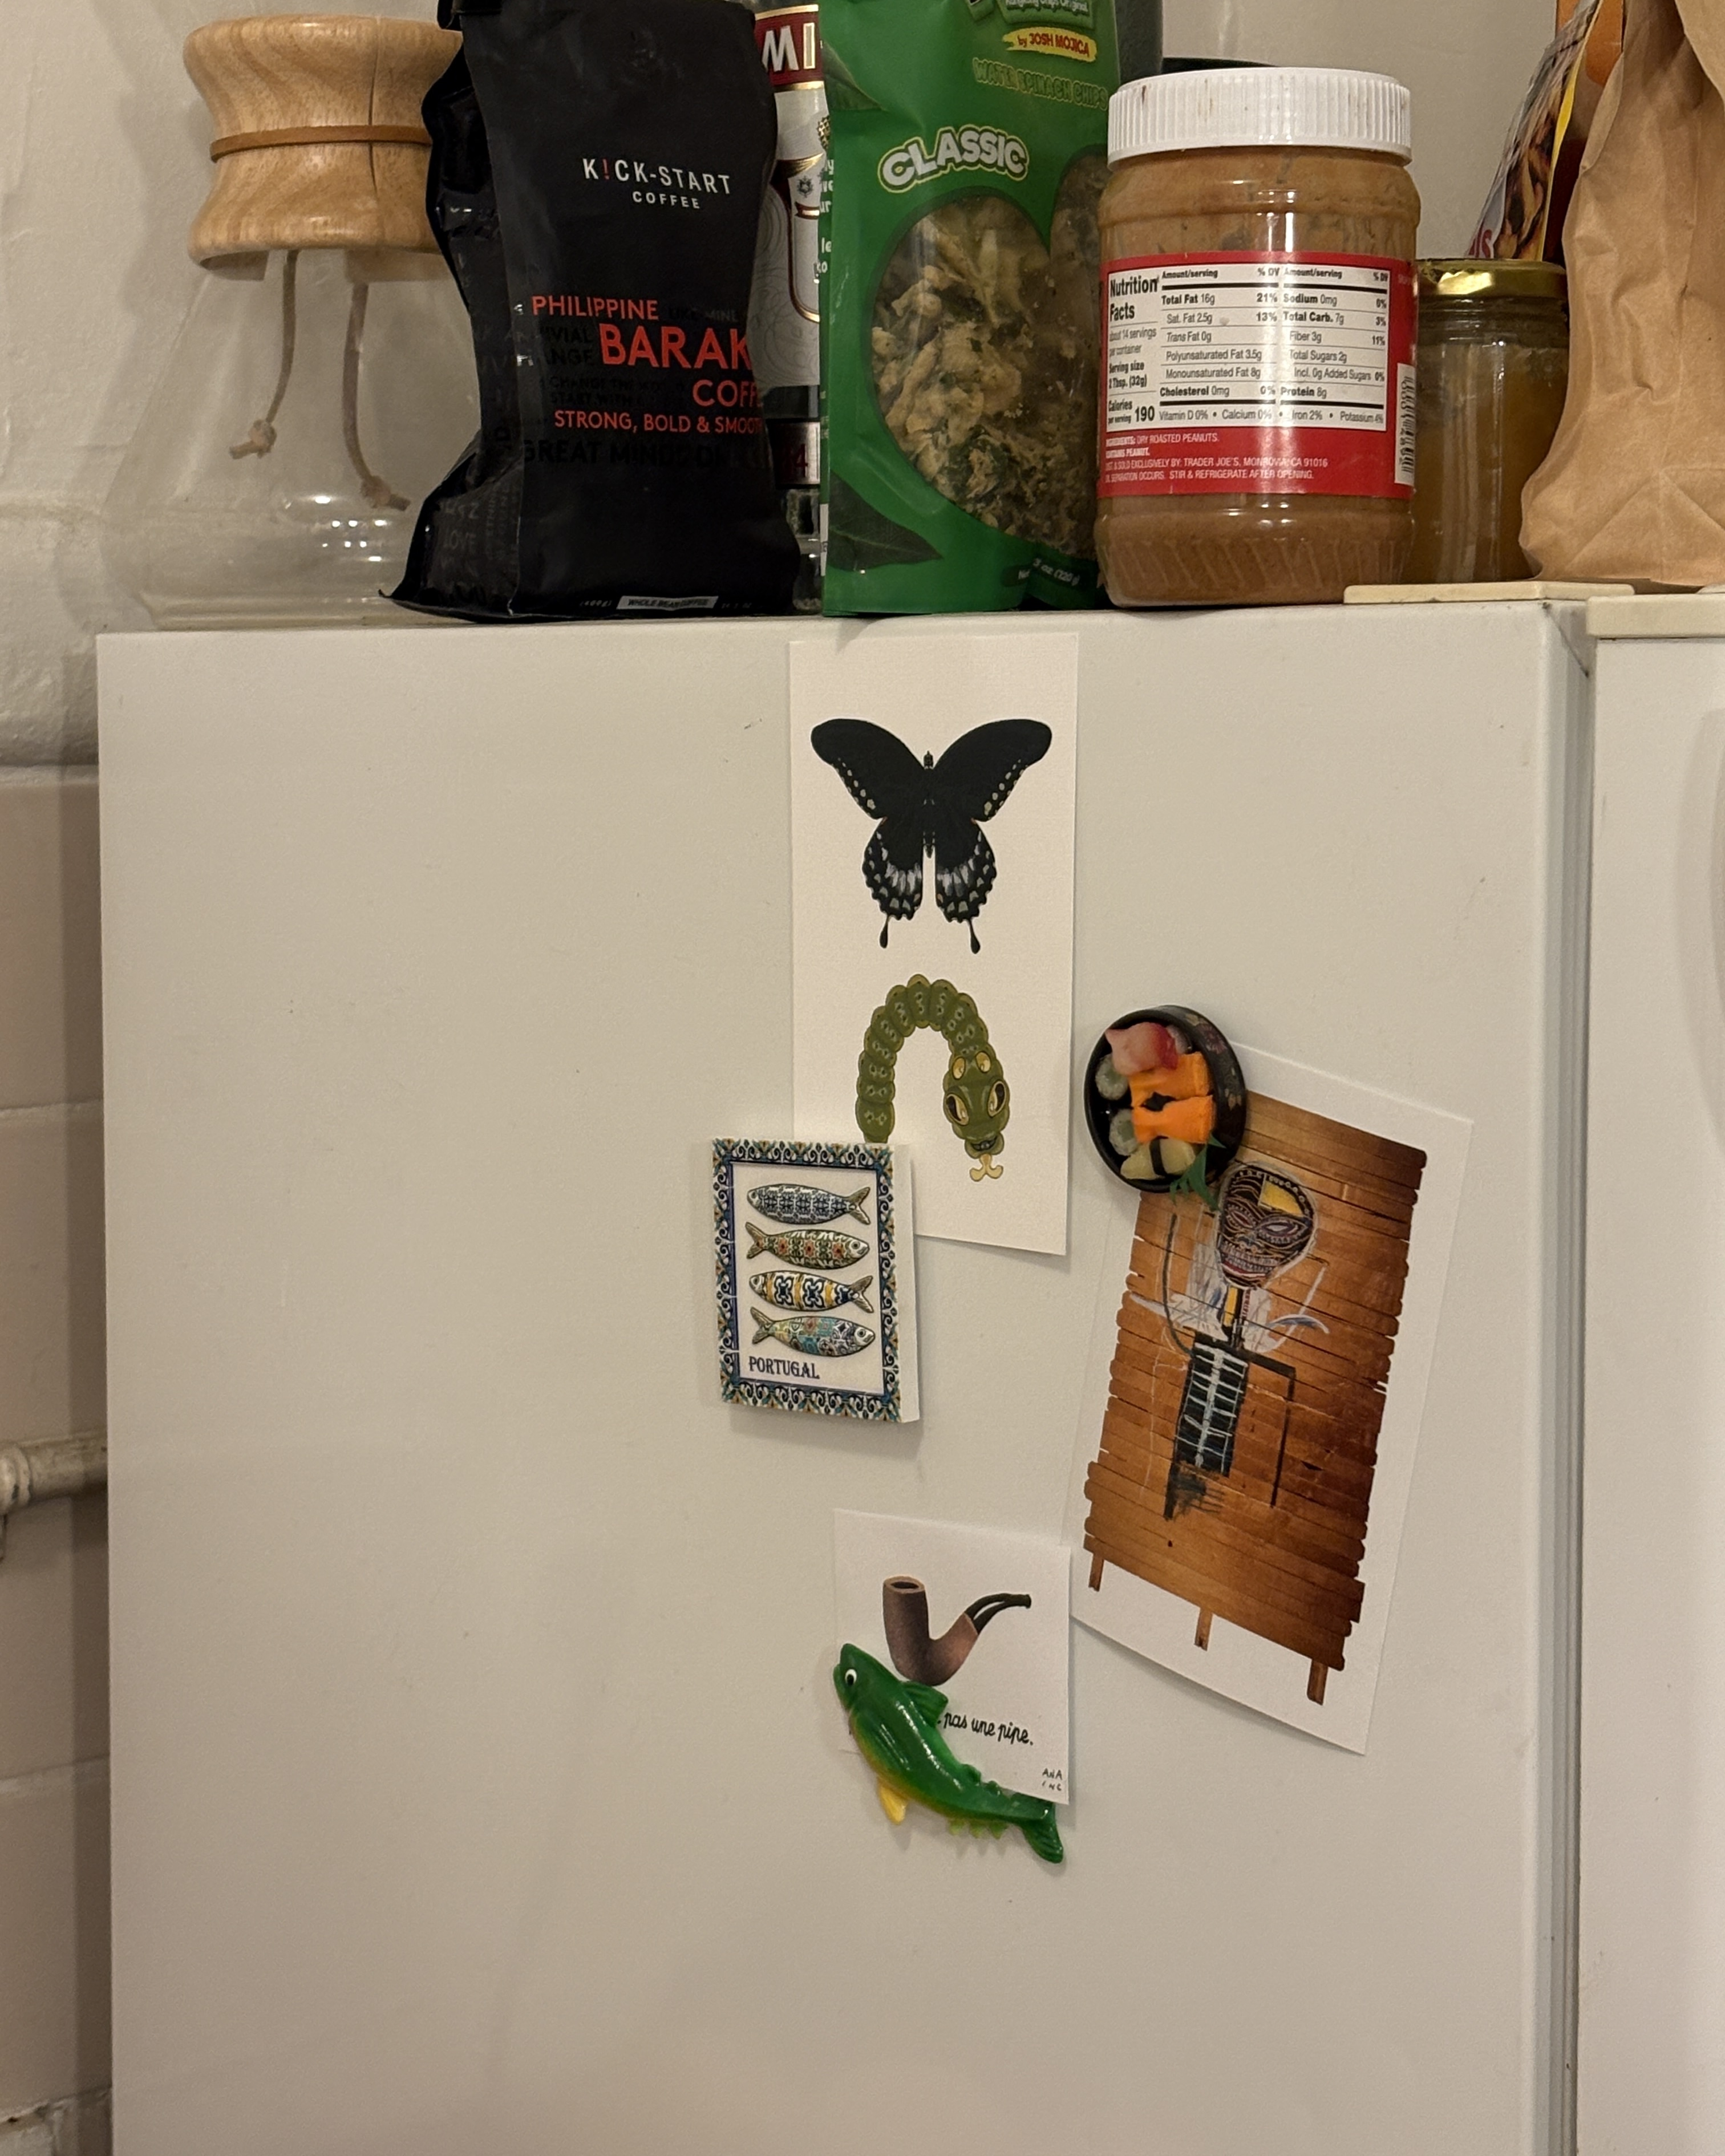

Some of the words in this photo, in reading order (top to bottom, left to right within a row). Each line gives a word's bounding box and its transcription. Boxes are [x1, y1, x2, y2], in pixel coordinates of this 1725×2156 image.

[1028, 33, 1054, 46] JOSH
[1055, 34, 1090, 56] MOJICA
[1073, 82, 1108, 110] CHIPS
[880, 128, 1028, 189] CLASSIC
[632, 191, 700, 209] COFFEE
[1162, 268, 1218, 279] Amount/serving
[1268, 268, 1280, 276] DV
[1285, 268, 1342, 279] Amount/serving
[1109, 275, 1159, 297] Nutrition
[1161, 294, 1182, 305] Total
[1184, 294, 1198, 304] Fat
[1201, 293, 1215, 306] 16g
[1256, 292, 1278, 303] 21%
[1284, 294, 1318, 303] Sodium
[1320, 294, 1338, 307] 0mg
[1376, 298, 1387, 309] 0%
[532, 295, 659, 322] PHILIPPINE
[1109, 302, 1135, 322] Facts
[1183, 313, 1196, 323] Fat
[1256, 312, 1277, 322] 13%
[1284, 311, 1307, 322] Total
[1309, 312, 1334, 322] Carb.
[1335, 313, 1345, 325] 7g
[1376, 317, 1386, 326] 3%
[1129, 326, 1157, 340] servings
[1167, 332, 1186, 342] Trans
[1187, 331, 1200, 342] Fat
[1201, 330, 1212, 343] 0g
[1290, 330, 1310, 341] Fiber
[1311, 331, 1322, 343] 3g
[1372, 335, 1386, 346] 11%
[1166, 350, 1228, 363] Polyunsaturated
[1230, 350, 1244, 360] Fat
[1245, 349, 1262, 362] 3.5g
[1290, 350, 1309, 360] Total
[1310, 350, 1338, 363] Sugars
[1338, 351, 1347, 364] 2g
[1109, 362, 1129, 374] Serving
[1130, 359, 1144, 371] size
[1166, 368, 1234, 379] Monounsaturated
[1236, 367, 1249, 378] Fat
[1250, 367, 1261, 380] 8g
[1129, 374, 1147, 388] (32g)
[1294, 367, 1310, 378] Incl.
[1312, 367, 1322, 380] 0g
[1323, 368, 1349, 379] Added
[1349, 370, 1371, 382] Sugars
[1374, 371, 1384, 382] 0%
[1160, 386, 1209, 397] Cholesterol
[1211, 385, 1230, 398] 0mg
[1260, 386, 1276, 395] 0%
[1281, 386, 1315, 396] Protein
[1317, 387, 1327, 399] 8g
[1108, 399, 1132, 412] Calories
[1135, 405, 1155, 422] 190
[1159, 410, 1186, 421] Vitamin
[1188, 410, 1194, 420] D
[1195, 410, 1209, 420] 0%
[1222, 409, 1256, 420] Calcium
[1292, 410, 1308, 419] Iron
[1309, 410, 1323, 420] 2%
[1341, 411, 1374, 422] Potassium
[554, 410, 639, 433] STRONG,
[643, 414, 691, 433] BOLD
[697, 416, 710, 433] &
[1136, 435, 1148, 445] DRY
[1149, 434, 1181, 444] ROASTED
[1183, 432, 1219, 443] PEANUTS.
[1131, 459, 1169, 469] EXCLUSIVELY
[1184, 458, 1214, 467] TRADER
[1291, 457, 1302, 467] CA
[1303, 458, 1329, 468] 91016
[1139, 471, 1165, 480] OCCURS.
[1170, 471, 1185, 480] STIR
[1187, 471, 1193, 479] &
[1195, 469, 1248, 479] REFRIGERATE
[1249, 469, 1275, 479] AFTER
[1277, 469, 1314, 479] OPENING.
[748, 1356, 820, 1380] PORTUGAL
[944, 1712, 967, 1729] pas
[971, 1717, 996, 1736] une
[998, 1721, 1033, 1745] pipe.
